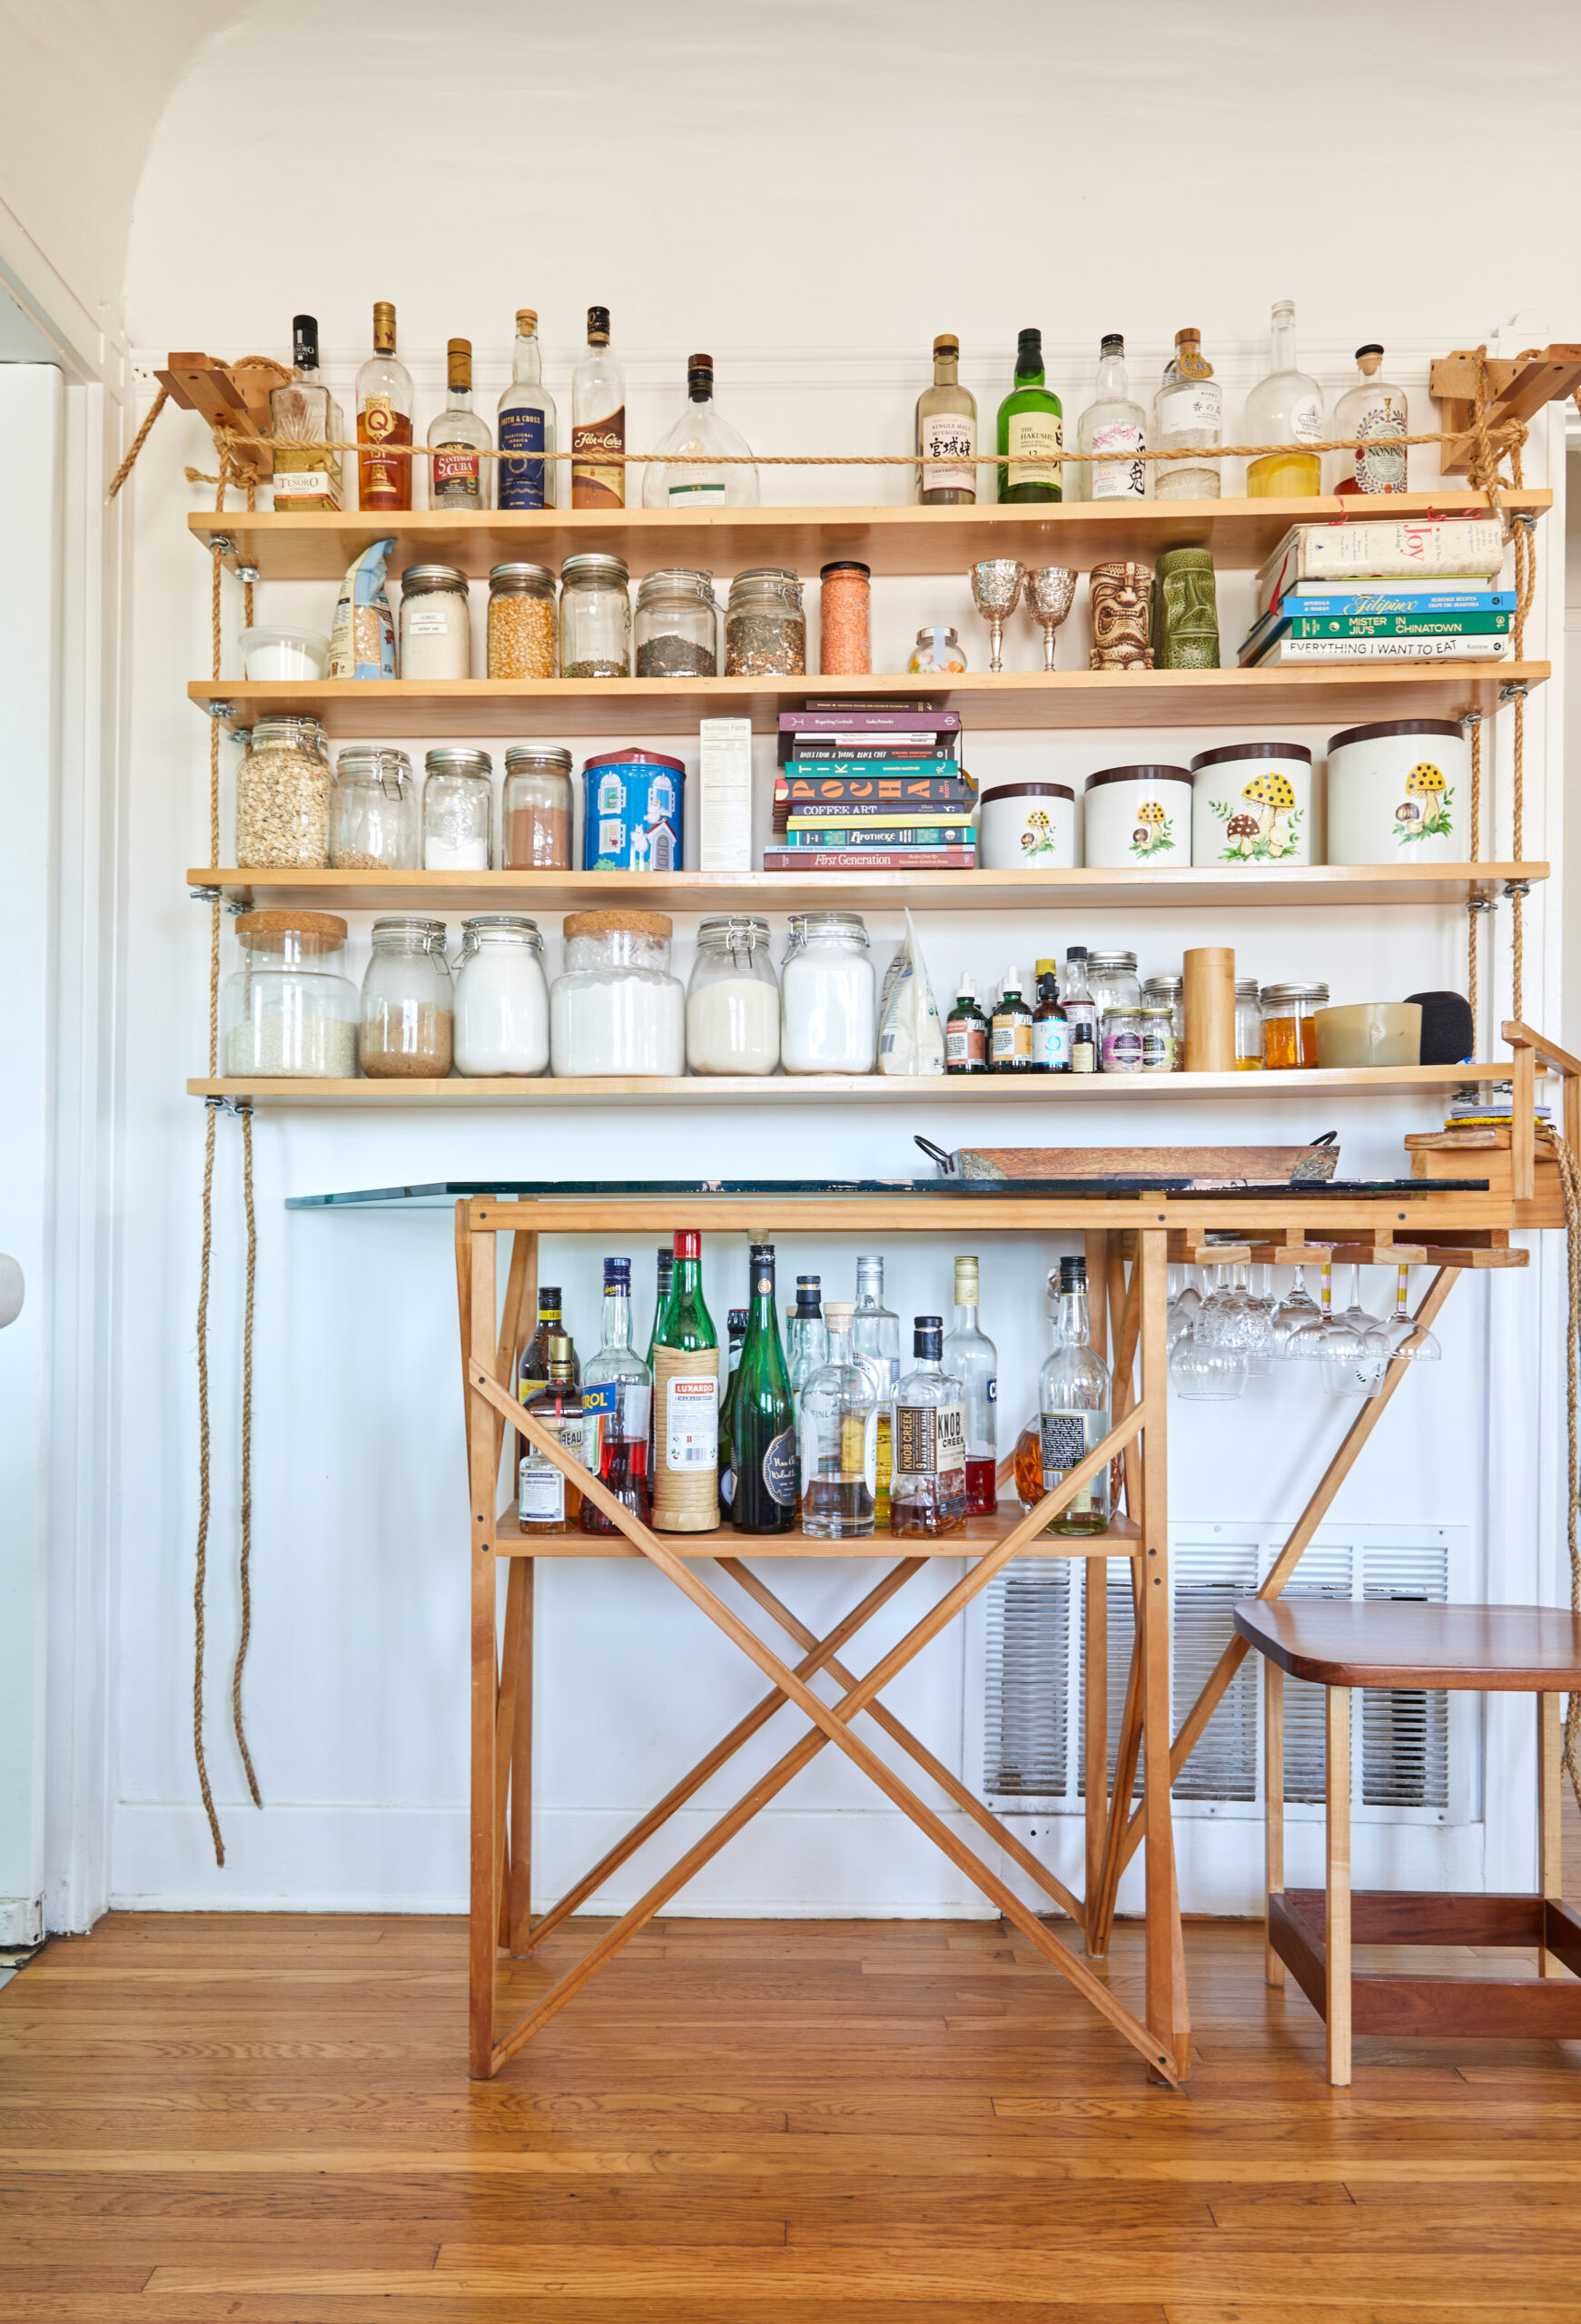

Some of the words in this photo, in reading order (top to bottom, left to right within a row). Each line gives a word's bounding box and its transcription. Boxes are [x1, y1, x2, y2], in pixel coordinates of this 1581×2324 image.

[368, 409, 390, 432] Q
[516, 415, 521, 423] &
[521, 415, 541, 424] CROSS
[574, 431, 598, 448] Flor
[603, 433, 623, 448] Caña
[446, 462, 473, 476] CUBA
[280, 477, 319, 488] TESORO
[1343, 595, 1418, 615] Filipinx
[1349, 617, 1388, 626] MISTER
[1395, 616, 1407, 625] IN
[1349, 625, 1375, 635] JIU'S
[1395, 623, 1463, 634] CHINATOWN
[1290, 643, 1368, 655] EVERYTHING
[1377, 644, 1414, 655] WANT
[1417, 645, 1433, 655] TO
[1436, 639, 1457, 654] EAT
[704, 724, 730, 732] Nutrition
[731, 724, 747, 732] Facts
[837, 750, 855, 759] YOUNG
[856, 751, 873, 759] BLACK
[873, 751, 887, 759] CHEF
[799, 763, 866, 773] TIKI
[792, 779, 931, 798] POCHA
[803, 805, 850, 815] COFFEE
[852, 805, 877, 814] ART
[850, 831, 896, 844] APOTHEKE
[814, 853, 837, 865] First
[837, 853, 891, 865] Generation
[677, 1384, 713, 1393] LUXARDO
[903, 1411, 913, 1442] CREEK
[938, 1412, 961, 1440] KNOB
[942, 1435, 964, 1448] CREEK
[903, 1444, 913, 1470] KNOB
